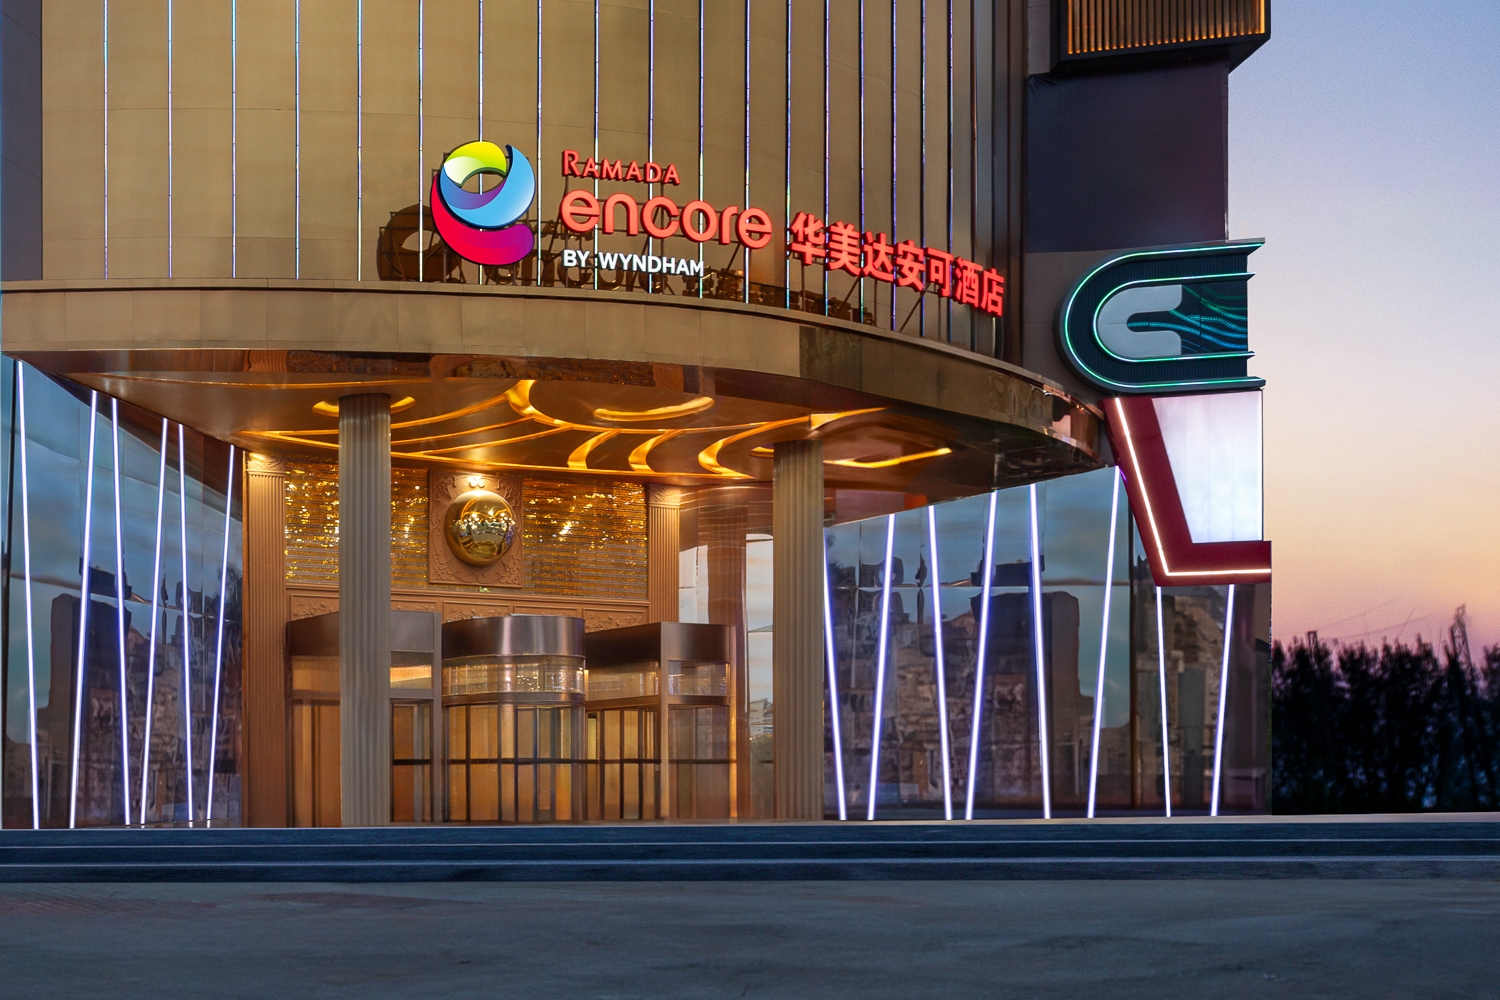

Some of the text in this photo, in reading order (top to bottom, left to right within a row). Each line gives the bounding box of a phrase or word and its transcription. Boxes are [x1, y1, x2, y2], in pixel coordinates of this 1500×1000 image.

[562, 150, 680, 185] RAMADA
[560, 189, 773, 249] encore
[562, 249, 590, 268] BY
[597, 251, 705, 277] WYNDHAM
[788, 211, 1005, 317] 华美达安可酒店
